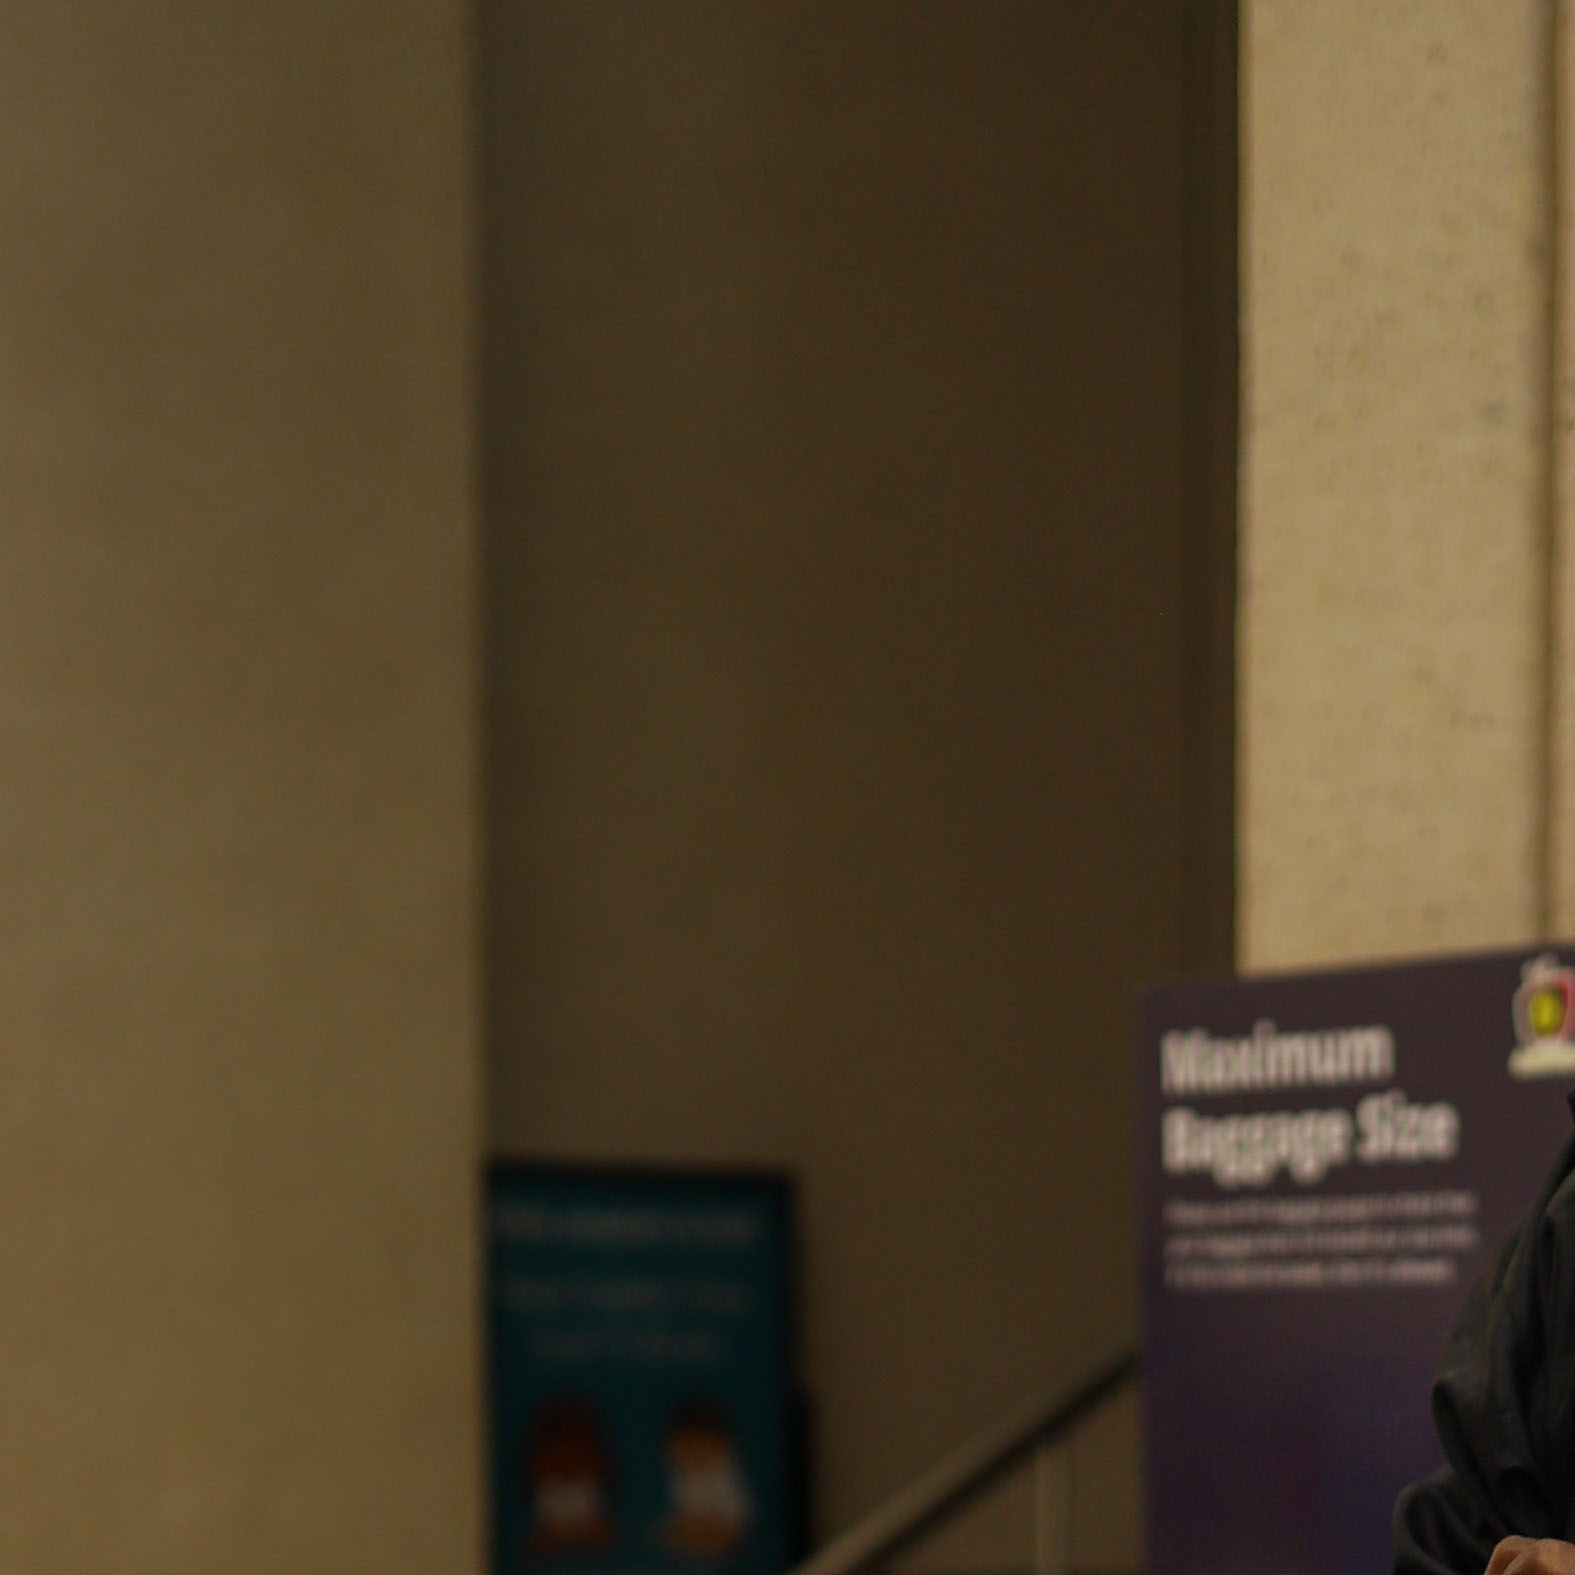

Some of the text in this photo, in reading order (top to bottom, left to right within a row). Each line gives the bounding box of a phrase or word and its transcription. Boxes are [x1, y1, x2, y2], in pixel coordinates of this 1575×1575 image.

[1160, 1020, 1396, 1094] Maximum
[1160, 1090, 1461, 1188] Baggage Size
